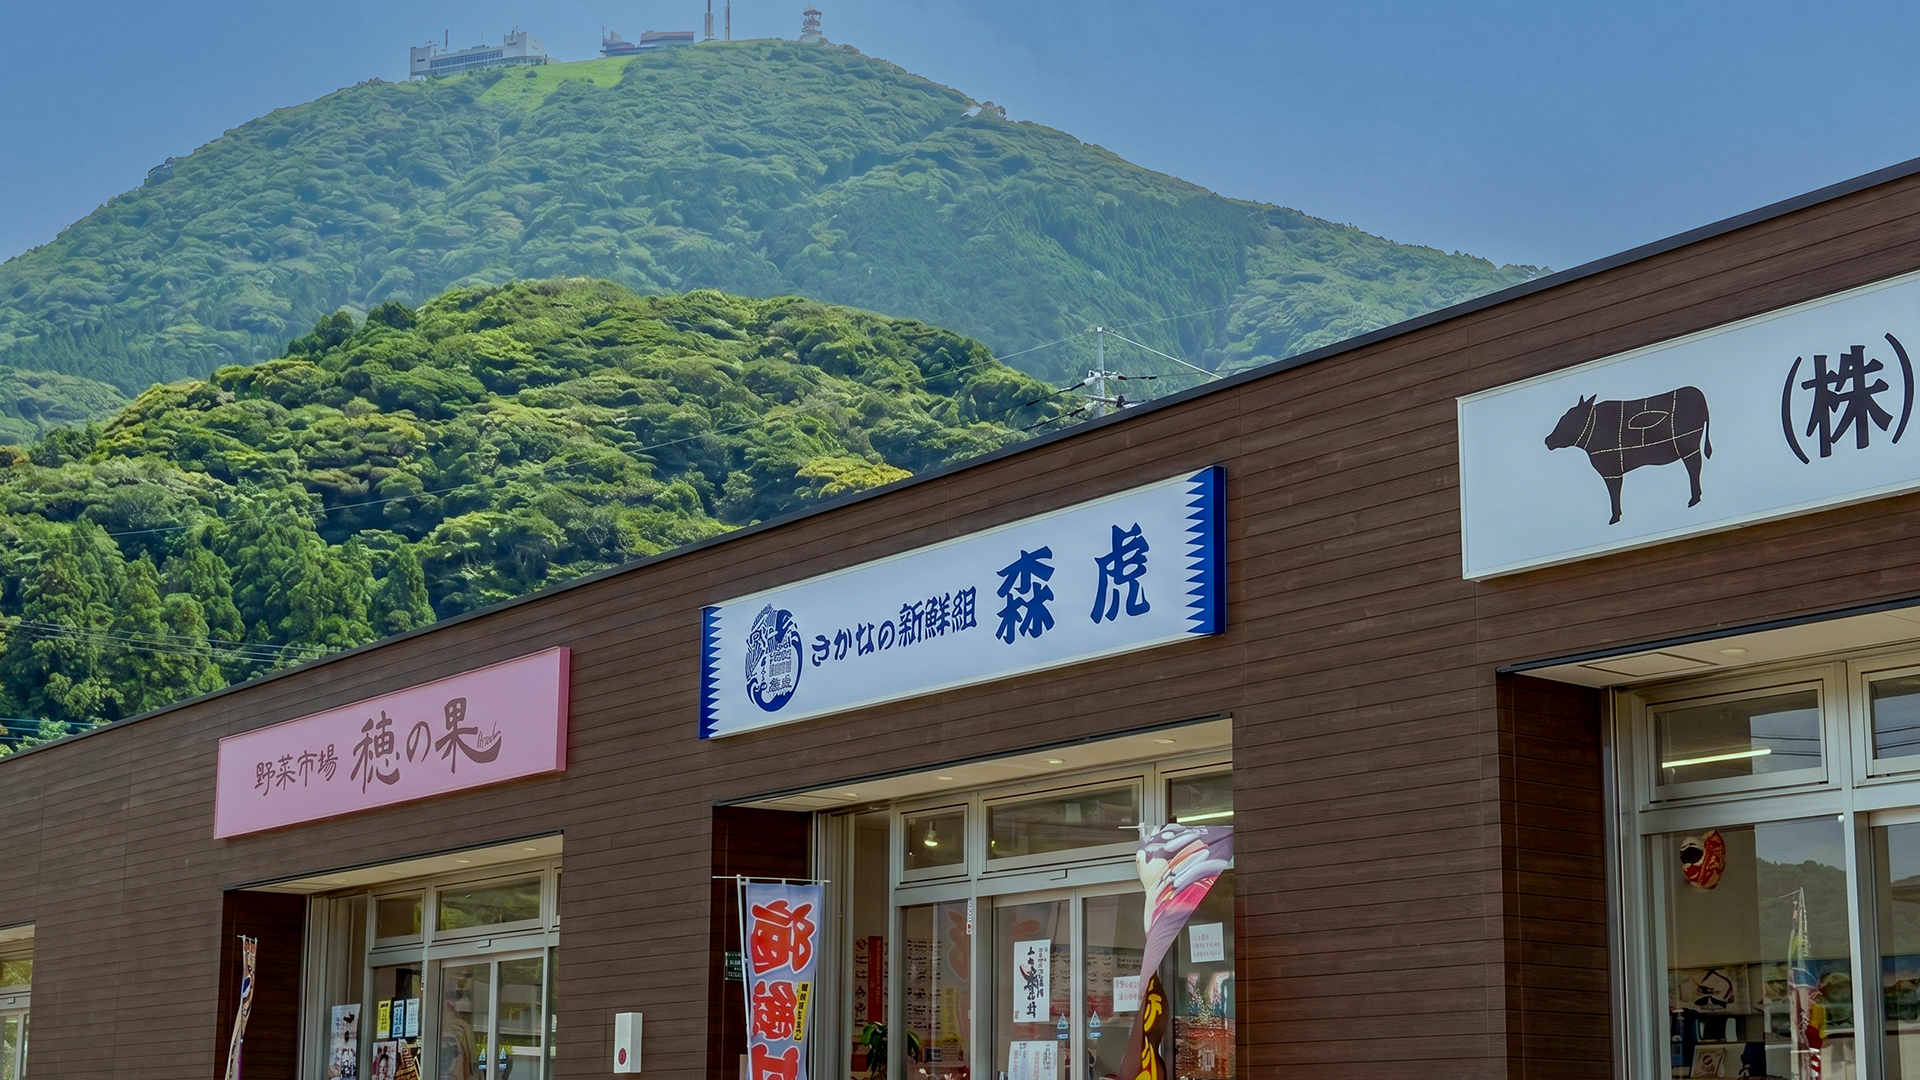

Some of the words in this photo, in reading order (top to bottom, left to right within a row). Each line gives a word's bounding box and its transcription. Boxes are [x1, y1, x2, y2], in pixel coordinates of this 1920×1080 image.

[1780, 332, 1915, 465] (株)
[811, 585, 978, 667] さかなの新鮮組
[254, 743, 339, 797] 野菜市場
[350, 697, 502, 794] 穂の果
